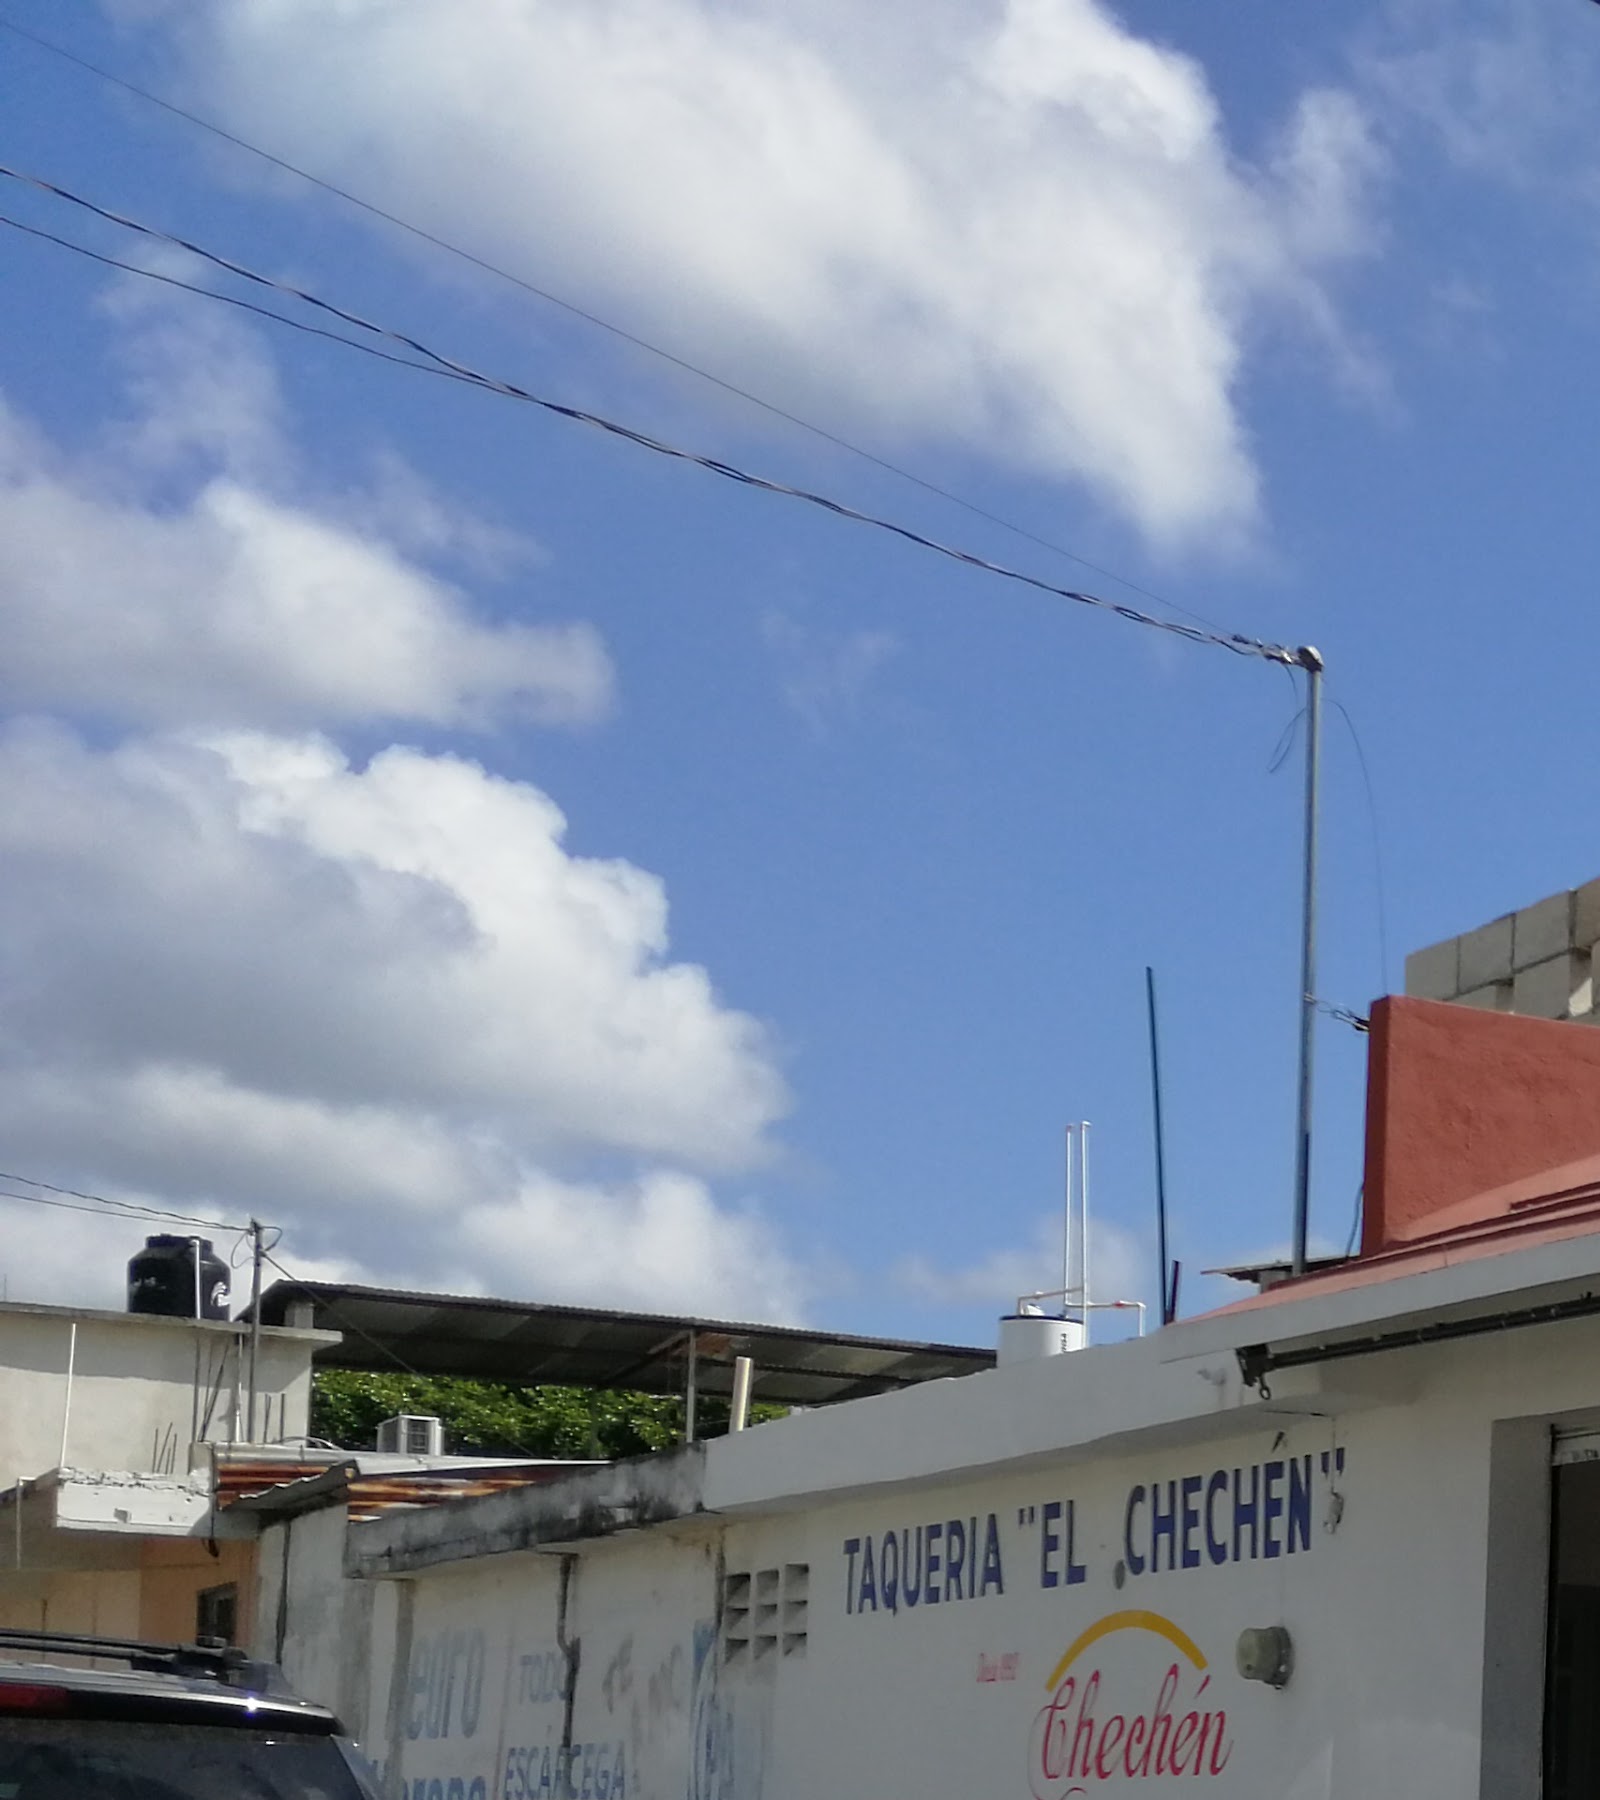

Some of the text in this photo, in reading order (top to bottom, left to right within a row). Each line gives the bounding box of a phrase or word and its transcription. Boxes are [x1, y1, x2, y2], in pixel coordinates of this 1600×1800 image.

[844, 1431, 1346, 1617] TAQUERIA "EL CHECHÉN"
